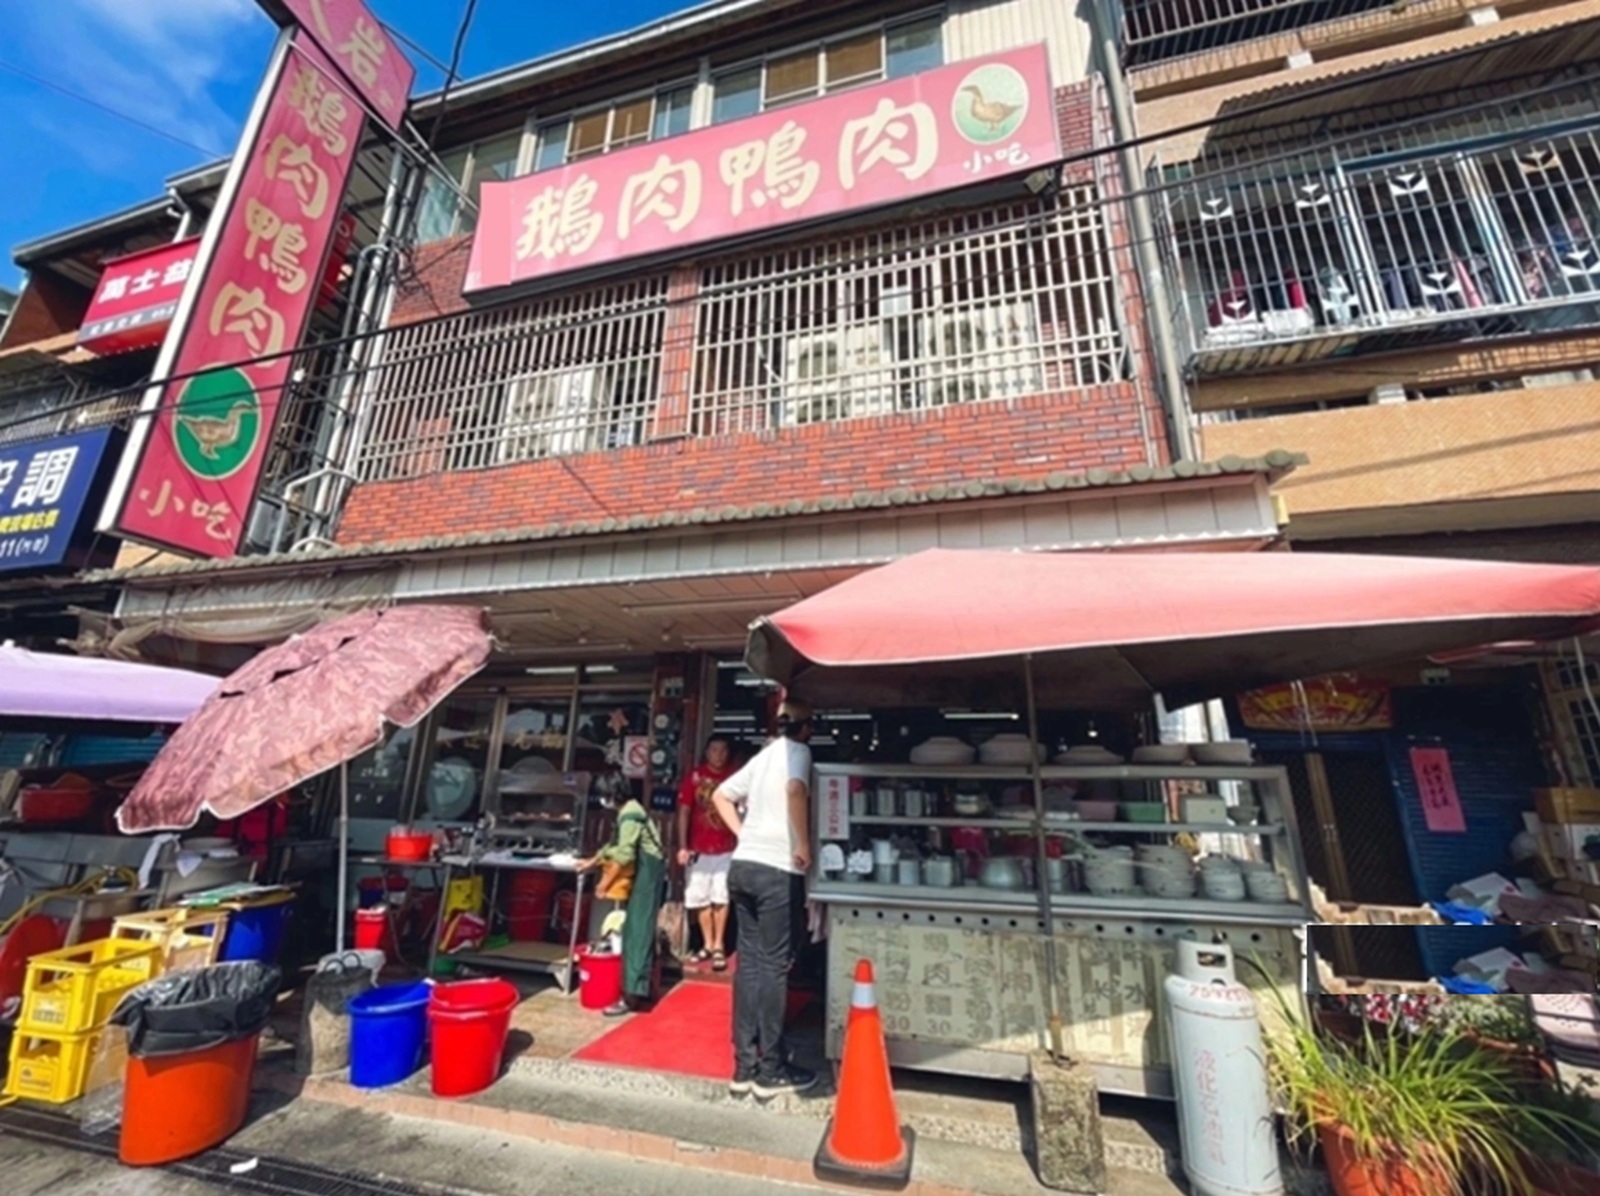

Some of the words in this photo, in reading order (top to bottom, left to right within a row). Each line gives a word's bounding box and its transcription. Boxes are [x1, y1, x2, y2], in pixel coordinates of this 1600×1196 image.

[516, 97, 939, 261] 鵝肉鴨肉
[962, 141, 1031, 174] 小吃
[209, 65, 348, 368] 鵝肉鴨肉
[139, 482, 232, 540] 小吃
